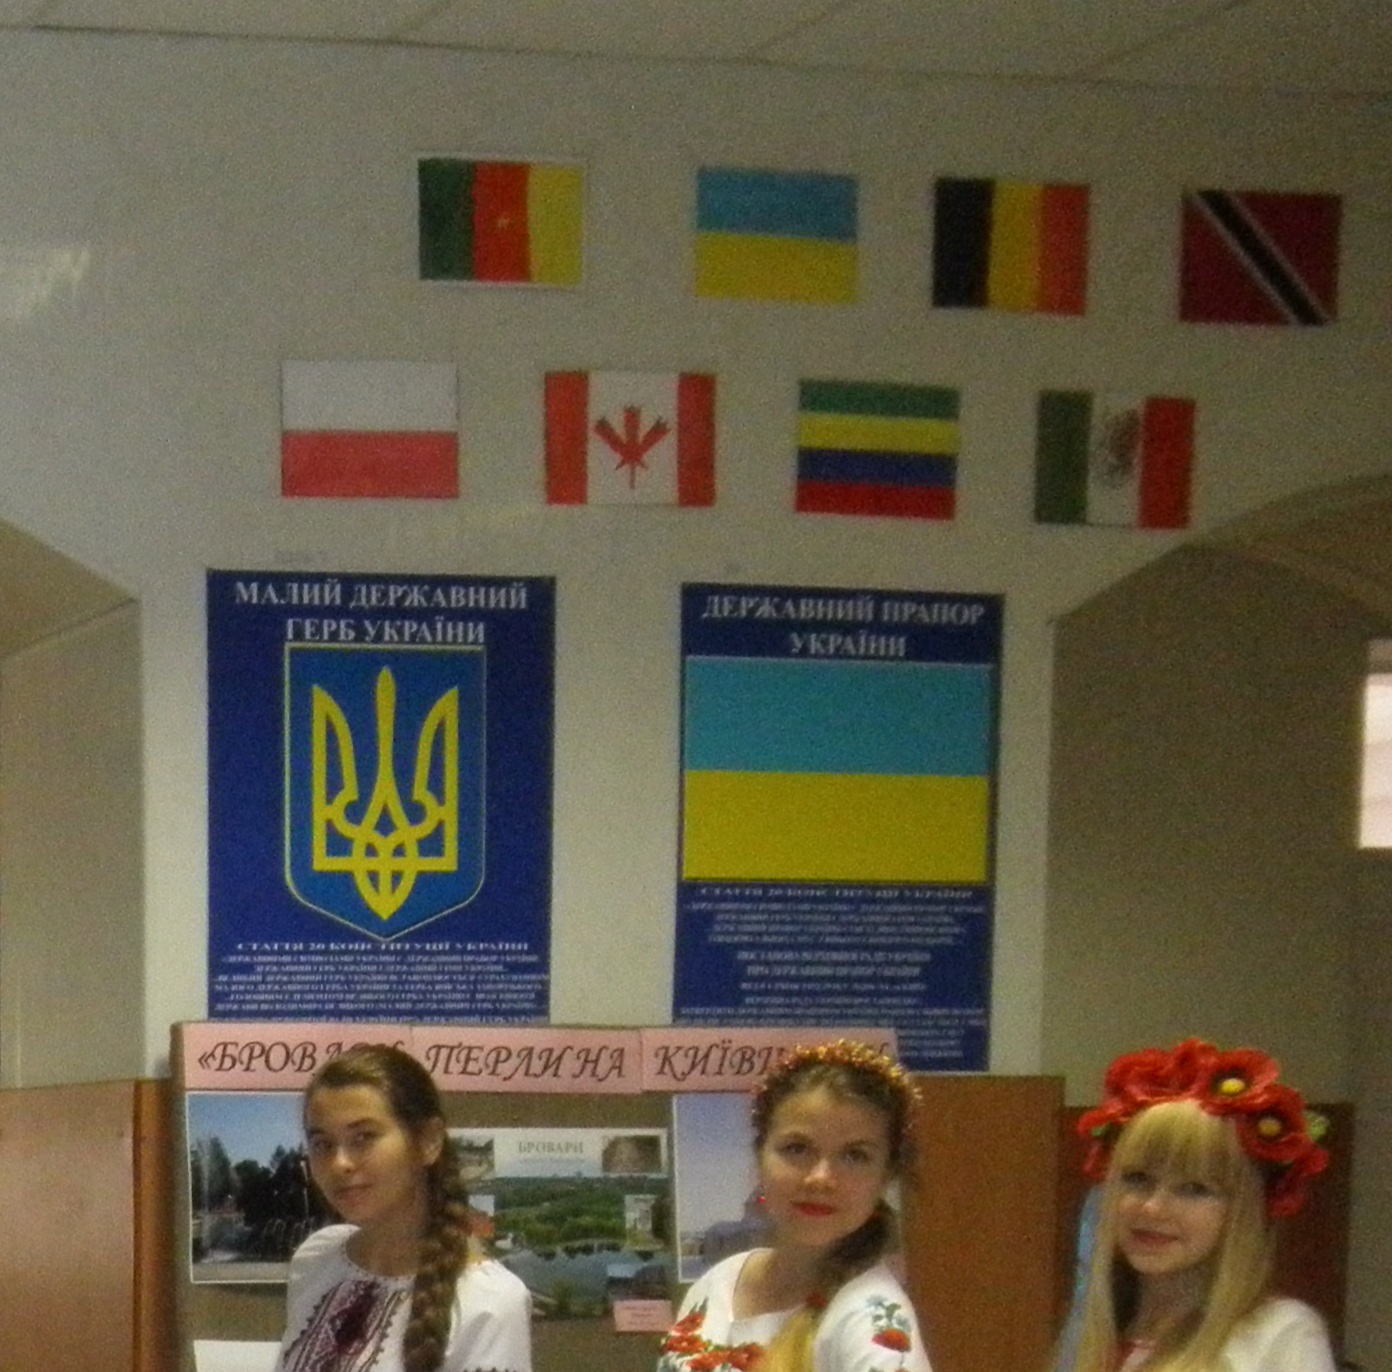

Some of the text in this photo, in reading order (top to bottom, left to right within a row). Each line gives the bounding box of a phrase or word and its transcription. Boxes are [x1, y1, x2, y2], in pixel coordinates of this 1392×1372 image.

[234, 578, 528, 610] МАЛИЙ ДЕРЖАВНИЙ
[702, 594, 986, 627] ДЕРЖАВНИЙ ПРАПОР
[285, 615, 486, 644] ГЕРБ УКРАЇНИ
[789, 630, 907, 658] УКРАЇНИ
[424, 1042, 627, 1083] ПЕРЛИНА
